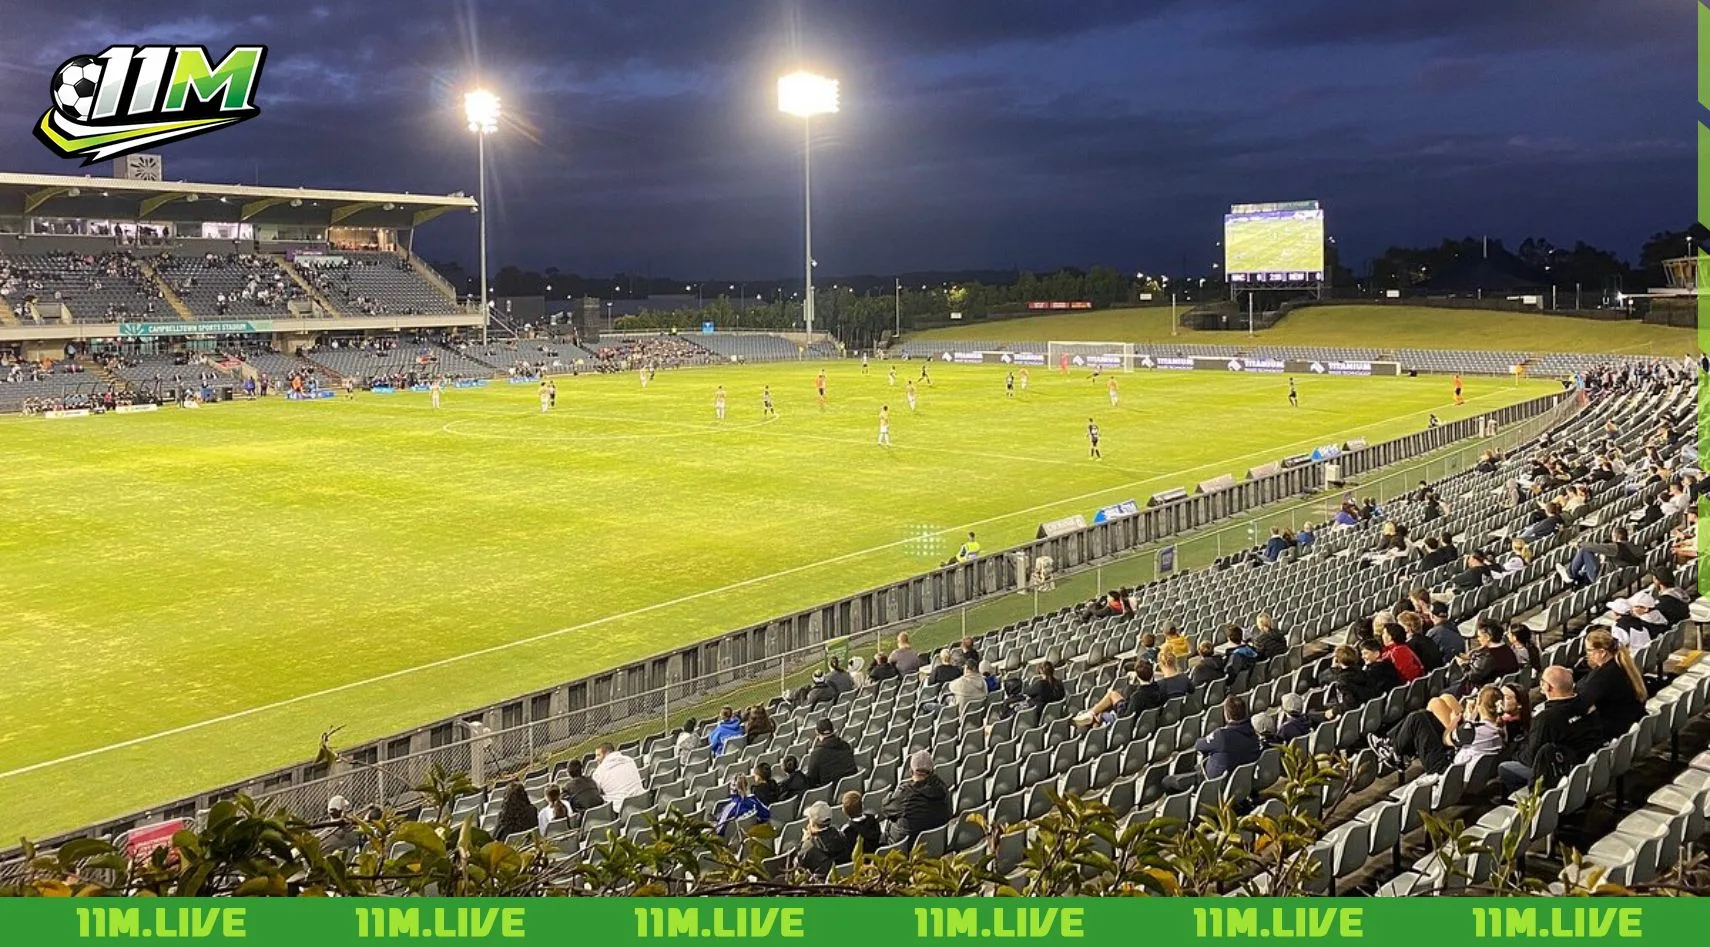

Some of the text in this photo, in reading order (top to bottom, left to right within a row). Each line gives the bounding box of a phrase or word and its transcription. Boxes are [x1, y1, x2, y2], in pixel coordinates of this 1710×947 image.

[148, 323, 246, 333] CAMPBELLTOWN SPORTS STADIUM
